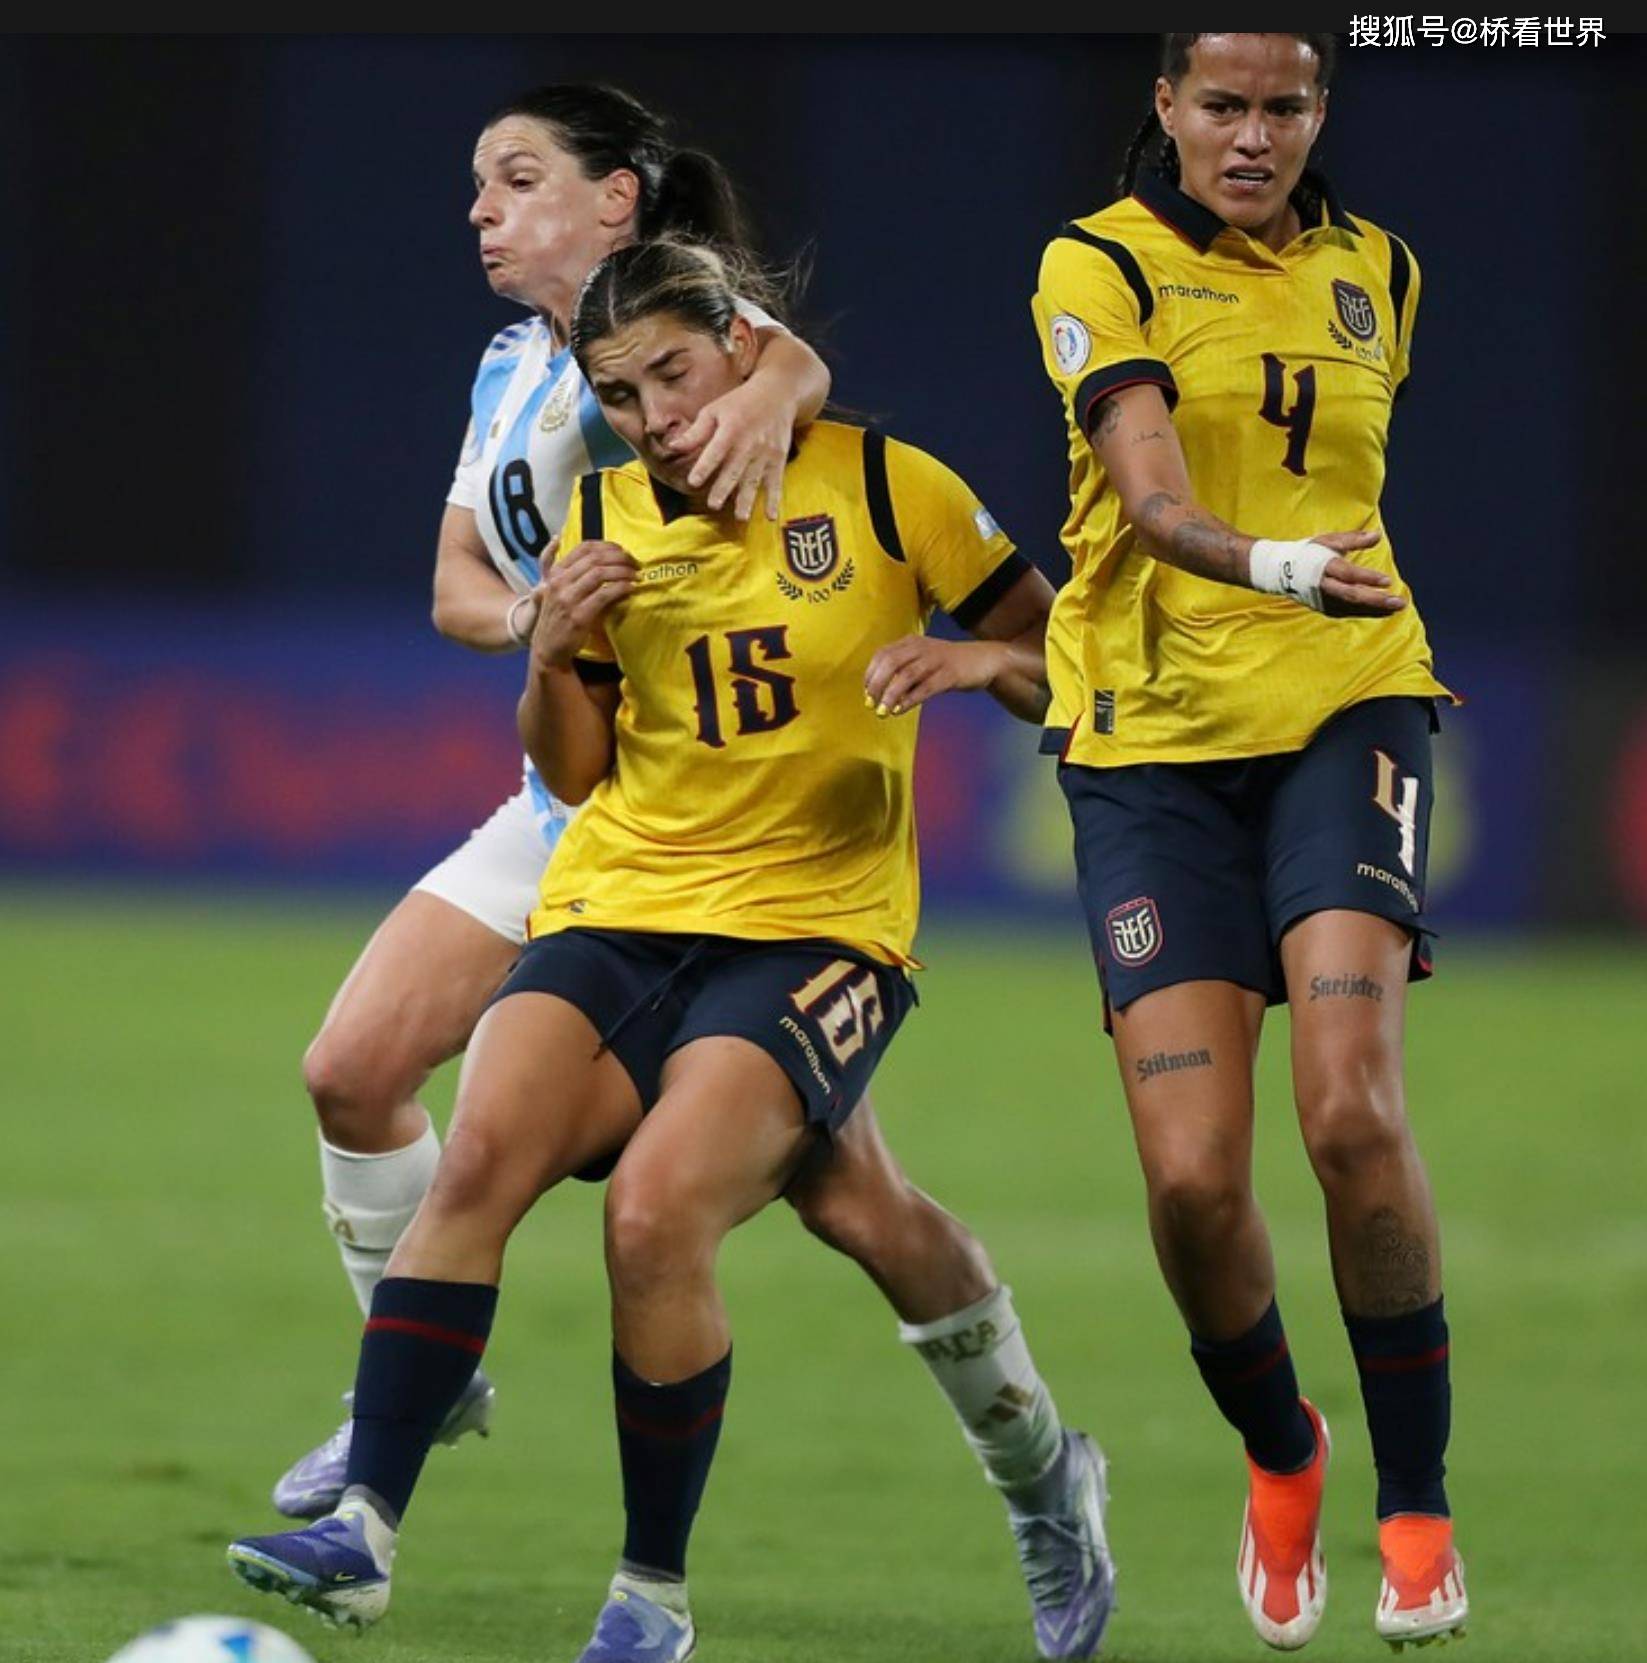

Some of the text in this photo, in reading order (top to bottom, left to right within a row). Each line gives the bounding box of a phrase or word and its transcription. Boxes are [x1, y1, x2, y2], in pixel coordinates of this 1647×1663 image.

[1158, 284, 1240, 304] marathon
[1259, 351, 1317, 477] 4
[489, 458, 553, 562] 18
[641, 562, 699, 581] rathon
[684, 624, 800, 749] 15
[1373, 749, 1420, 877] 4
[778, 1014, 832, 1094] marathon
[789, 958, 884, 1068] 15
